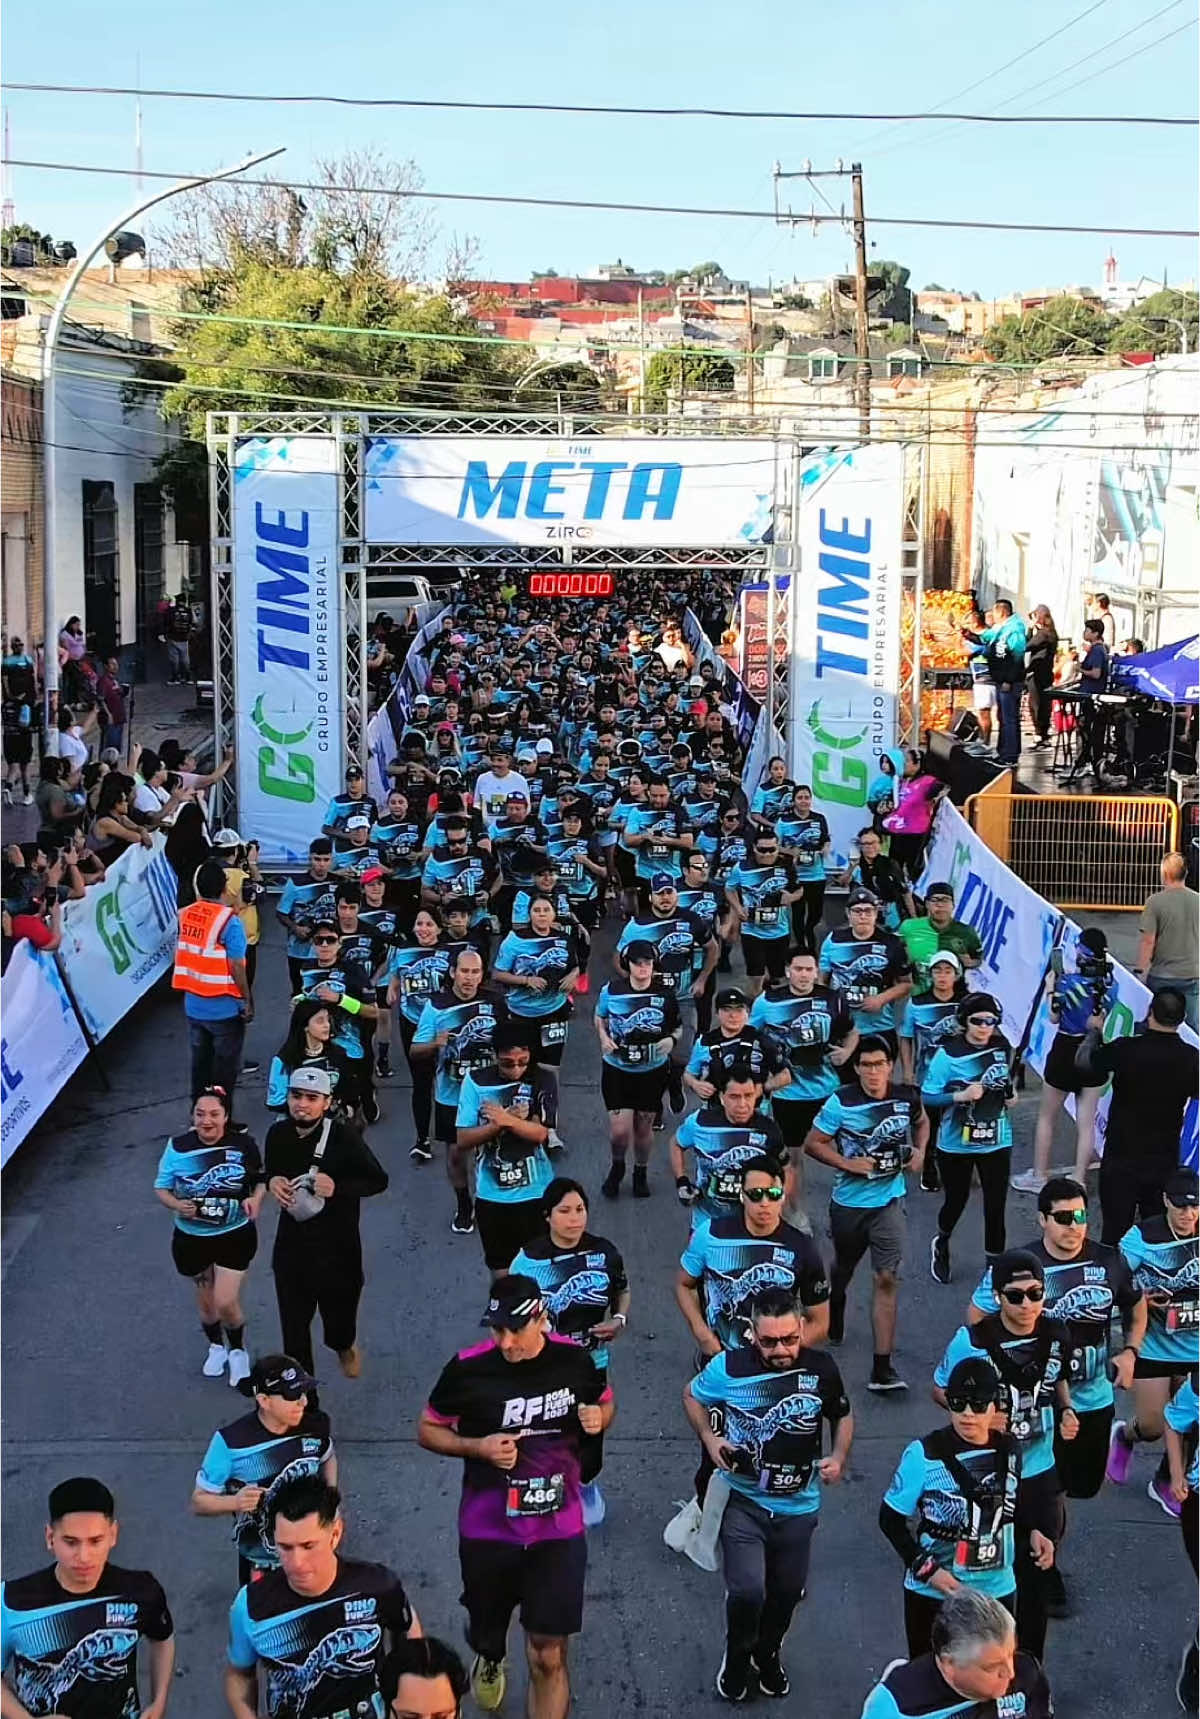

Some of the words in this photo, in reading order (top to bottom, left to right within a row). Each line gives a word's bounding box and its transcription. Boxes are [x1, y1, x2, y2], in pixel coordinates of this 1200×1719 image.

[457, 461, 683, 520] META
[255, 501, 311, 673] TIME
[815, 508, 872, 678] TIME
[315, 555, 328, 682] EMPRESARIAL
[875, 563, 888, 687] EMPRESARIAL
[317, 691, 328, 753] GRUPO
[873, 696, 885, 756] GRUPO
[954, 871, 1015, 974] TIME
[502, 1396, 544, 1428] RF
[545, 1388, 570, 1402] ROSA
[523, 1488, 556, 1504] 486
[774, 1474, 802, 1486] 304
[977, 1544, 997, 1560] 50
[106, 1602, 138, 1616] DINO
[344, 1598, 377, 1613] DINO
